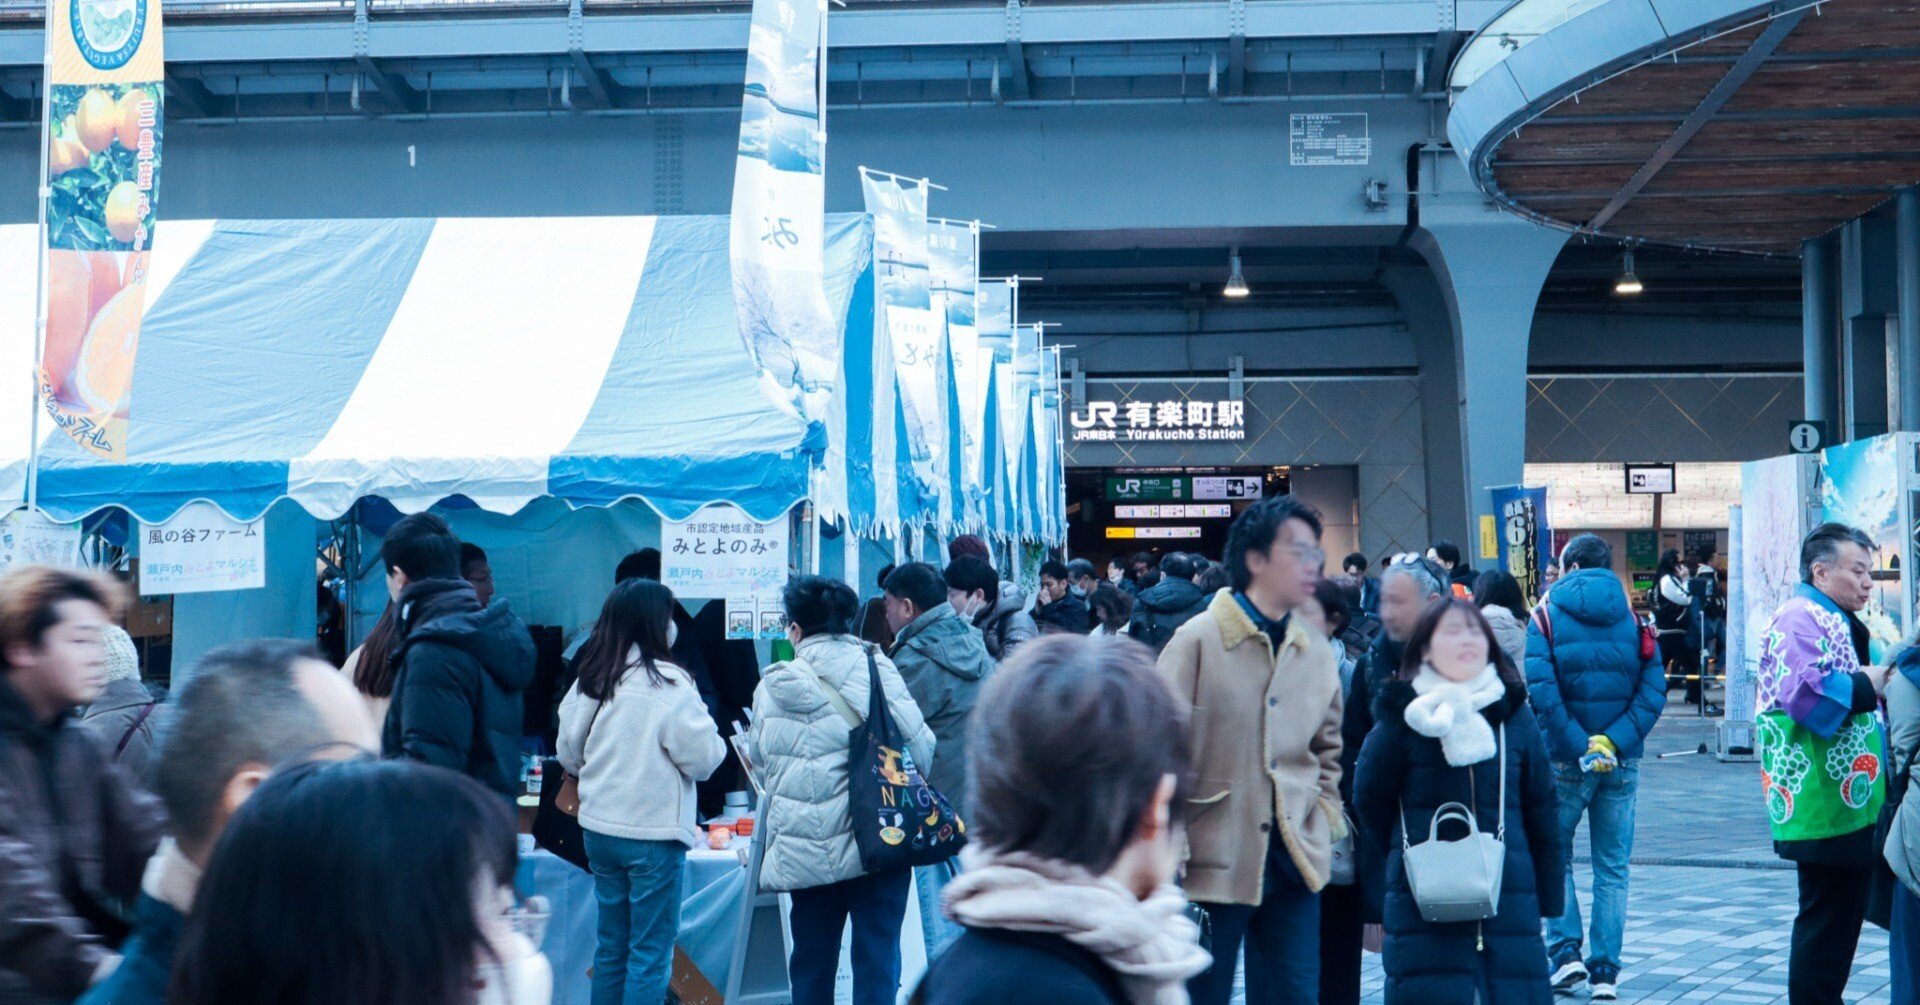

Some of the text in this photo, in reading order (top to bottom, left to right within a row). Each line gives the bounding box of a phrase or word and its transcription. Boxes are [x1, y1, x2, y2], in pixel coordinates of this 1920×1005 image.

[407, 145, 416, 167] 1
[1071, 401, 1244, 428] JR 有楽町駅
[1073, 430, 1116, 440] JR東日本
[1198, 429, 1245, 440] Station
[1116, 479, 1140, 493] JR
[148, 523, 257, 545] 風の谷ファーム
[686, 523, 764, 534] 市認定地域産品
